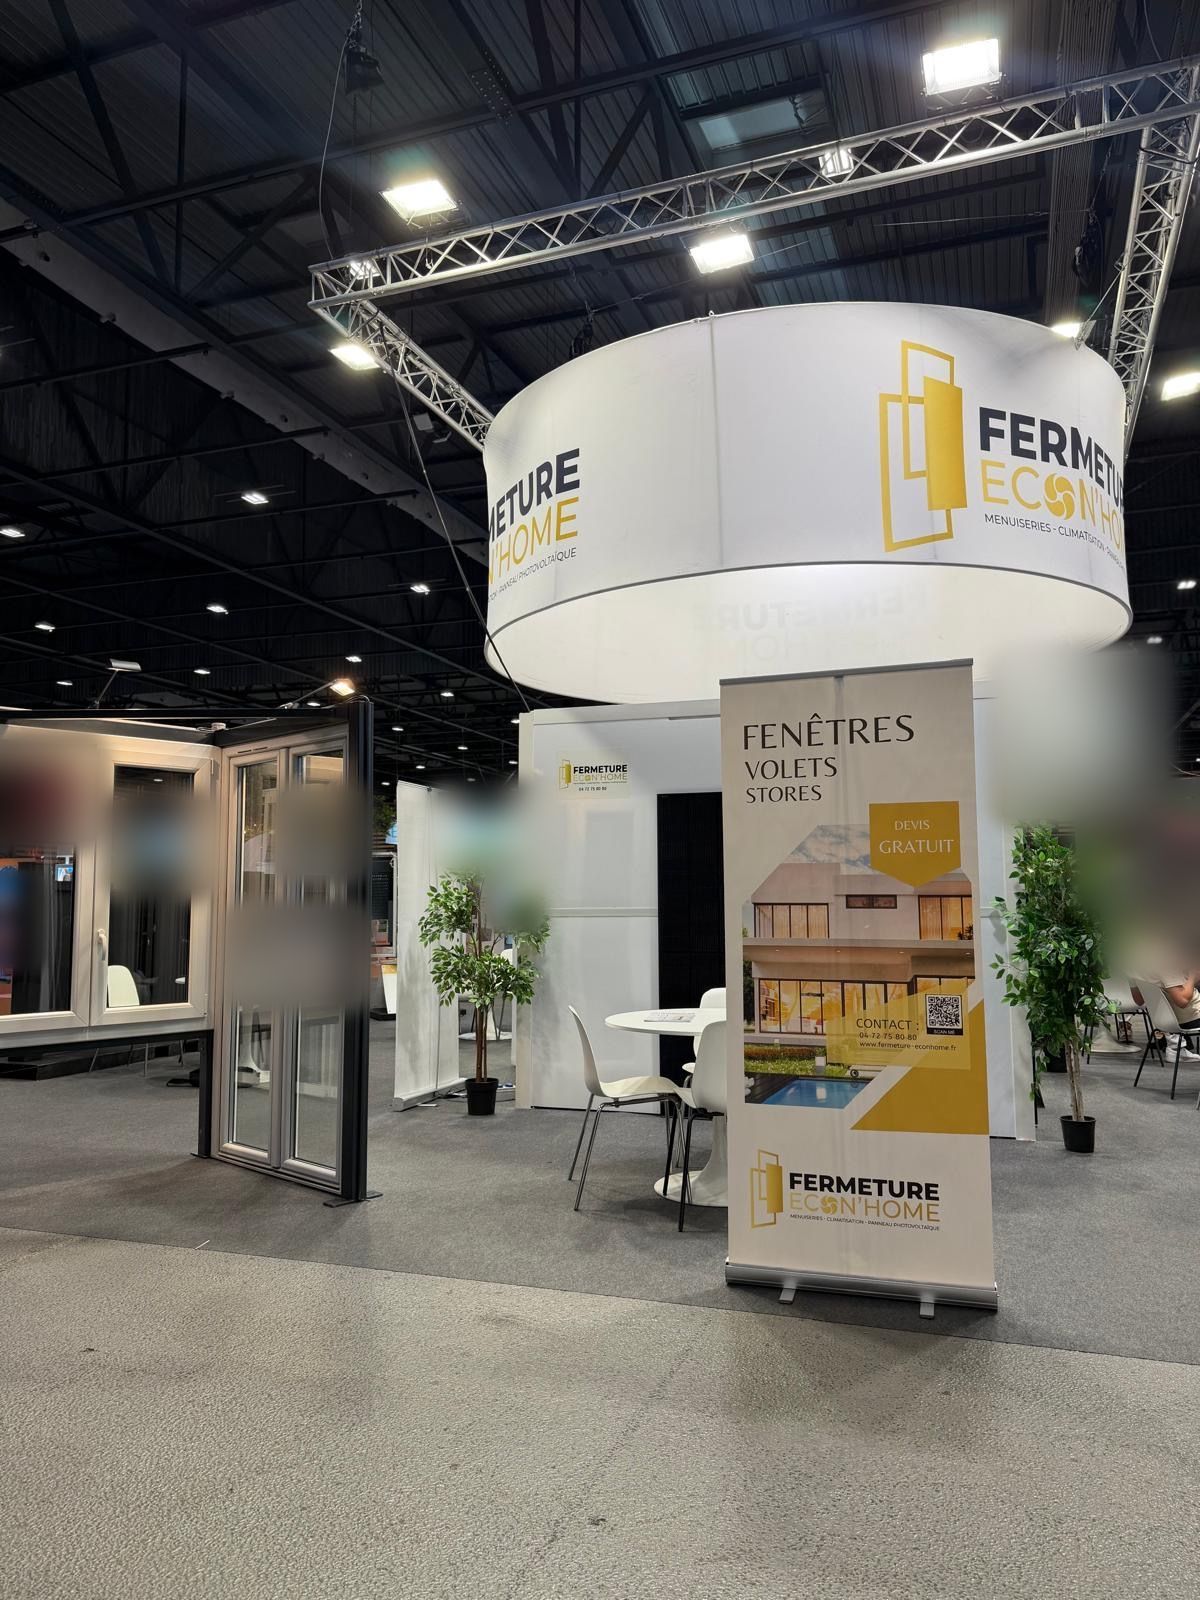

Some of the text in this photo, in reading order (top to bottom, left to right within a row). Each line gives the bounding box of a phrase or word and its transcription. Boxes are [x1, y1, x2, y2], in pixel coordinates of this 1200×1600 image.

[984, 513, 1052, 533] MENUISERIES
[743, 712, 915, 750] FENÊTRES
[573, 764, 628, 774] FERMETURE
[744, 757, 838, 781] VOLETS
[746, 785, 823, 804] STORES
[894, 819, 930, 831] DEVIS
[879, 839, 955, 854] GRATUIT
[856, 1018, 912, 1030] CONTACT
[895, 1033, 905, 1041] 80
[789, 1172, 940, 1201] FERMETURE
